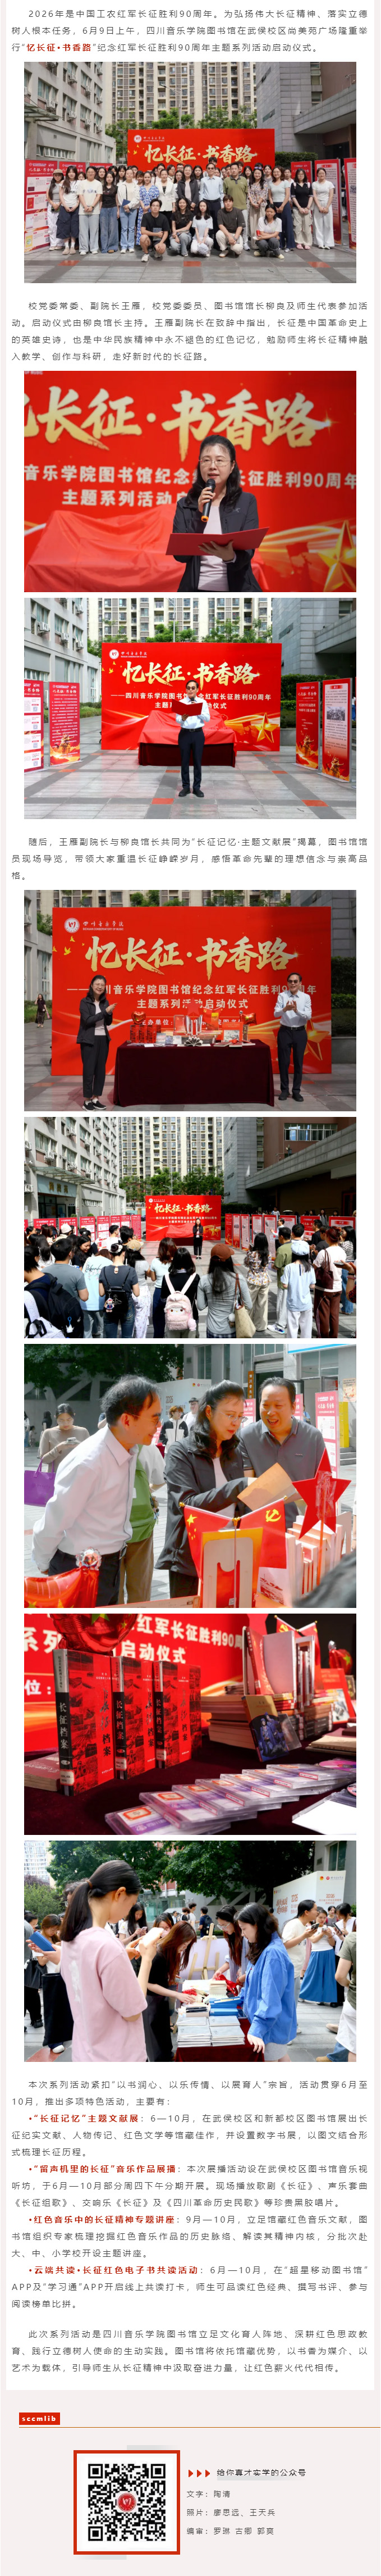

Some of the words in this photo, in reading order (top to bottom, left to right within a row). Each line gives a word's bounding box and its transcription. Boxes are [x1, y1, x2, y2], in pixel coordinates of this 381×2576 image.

[29, 10, 367, 18] 2026年是中国工农红军长征胜利90周年。为弘扬伟大长征精神、落实立德
[12, 26, 367, 35] 树人根本任务，6月9日上午，四川音乐学院图书馆在武侯校区尚美苑广场隆重举
[12, 319, 367, 327] 动。启动仪式由柳良馆长主持。王雁副院长在致辞中指出，长征是中国革命史上
[12, 335, 368, 344] 的英雄史诗，也是中华民族精神中永不褪色的红色记忆，勉励师生将长征精神融
[12, 352, 206, 361] 入教学、创作与科研，走好新时代的长征路。
[62, 489, 186, 507] 主题系列活动
[12, 855, 367, 863] 员现场导览，带领大家重温长征峥嵘岁月，感悟革命先辈的理想信念与崇高品
[85, 935, 297, 981] 忆长征·书香路
[58, 1702, 69, 1749] 长征档案
[12, 2097, 169, 2106] 10月，推出多项特色活动，主要有：
[12, 2131, 367, 2139] 征纪实文献、人物传记、红色文学等馆藏佳作，并设置数字书展，以图文结合形
[12, 2232, 367, 2241] 书馆组织专家梳理挖掘红色音乐作品的历史脉络、解读其精神内核，分批次赴
[29, 2330, 367, 2338] 此次系列活动是四川音乐学院图书馆立足文化育人阵地、深耕红色思政教
[12, 2347, 367, 2355] 育、践行立德树人使命的生动实践。图书馆将依托馆藏优势，以书香为媒介、以
[12, 2364, 338, 2372] 艺术为载体，引导师生从长征精神中汲取奋进力量，让红色薪火代代相传。
